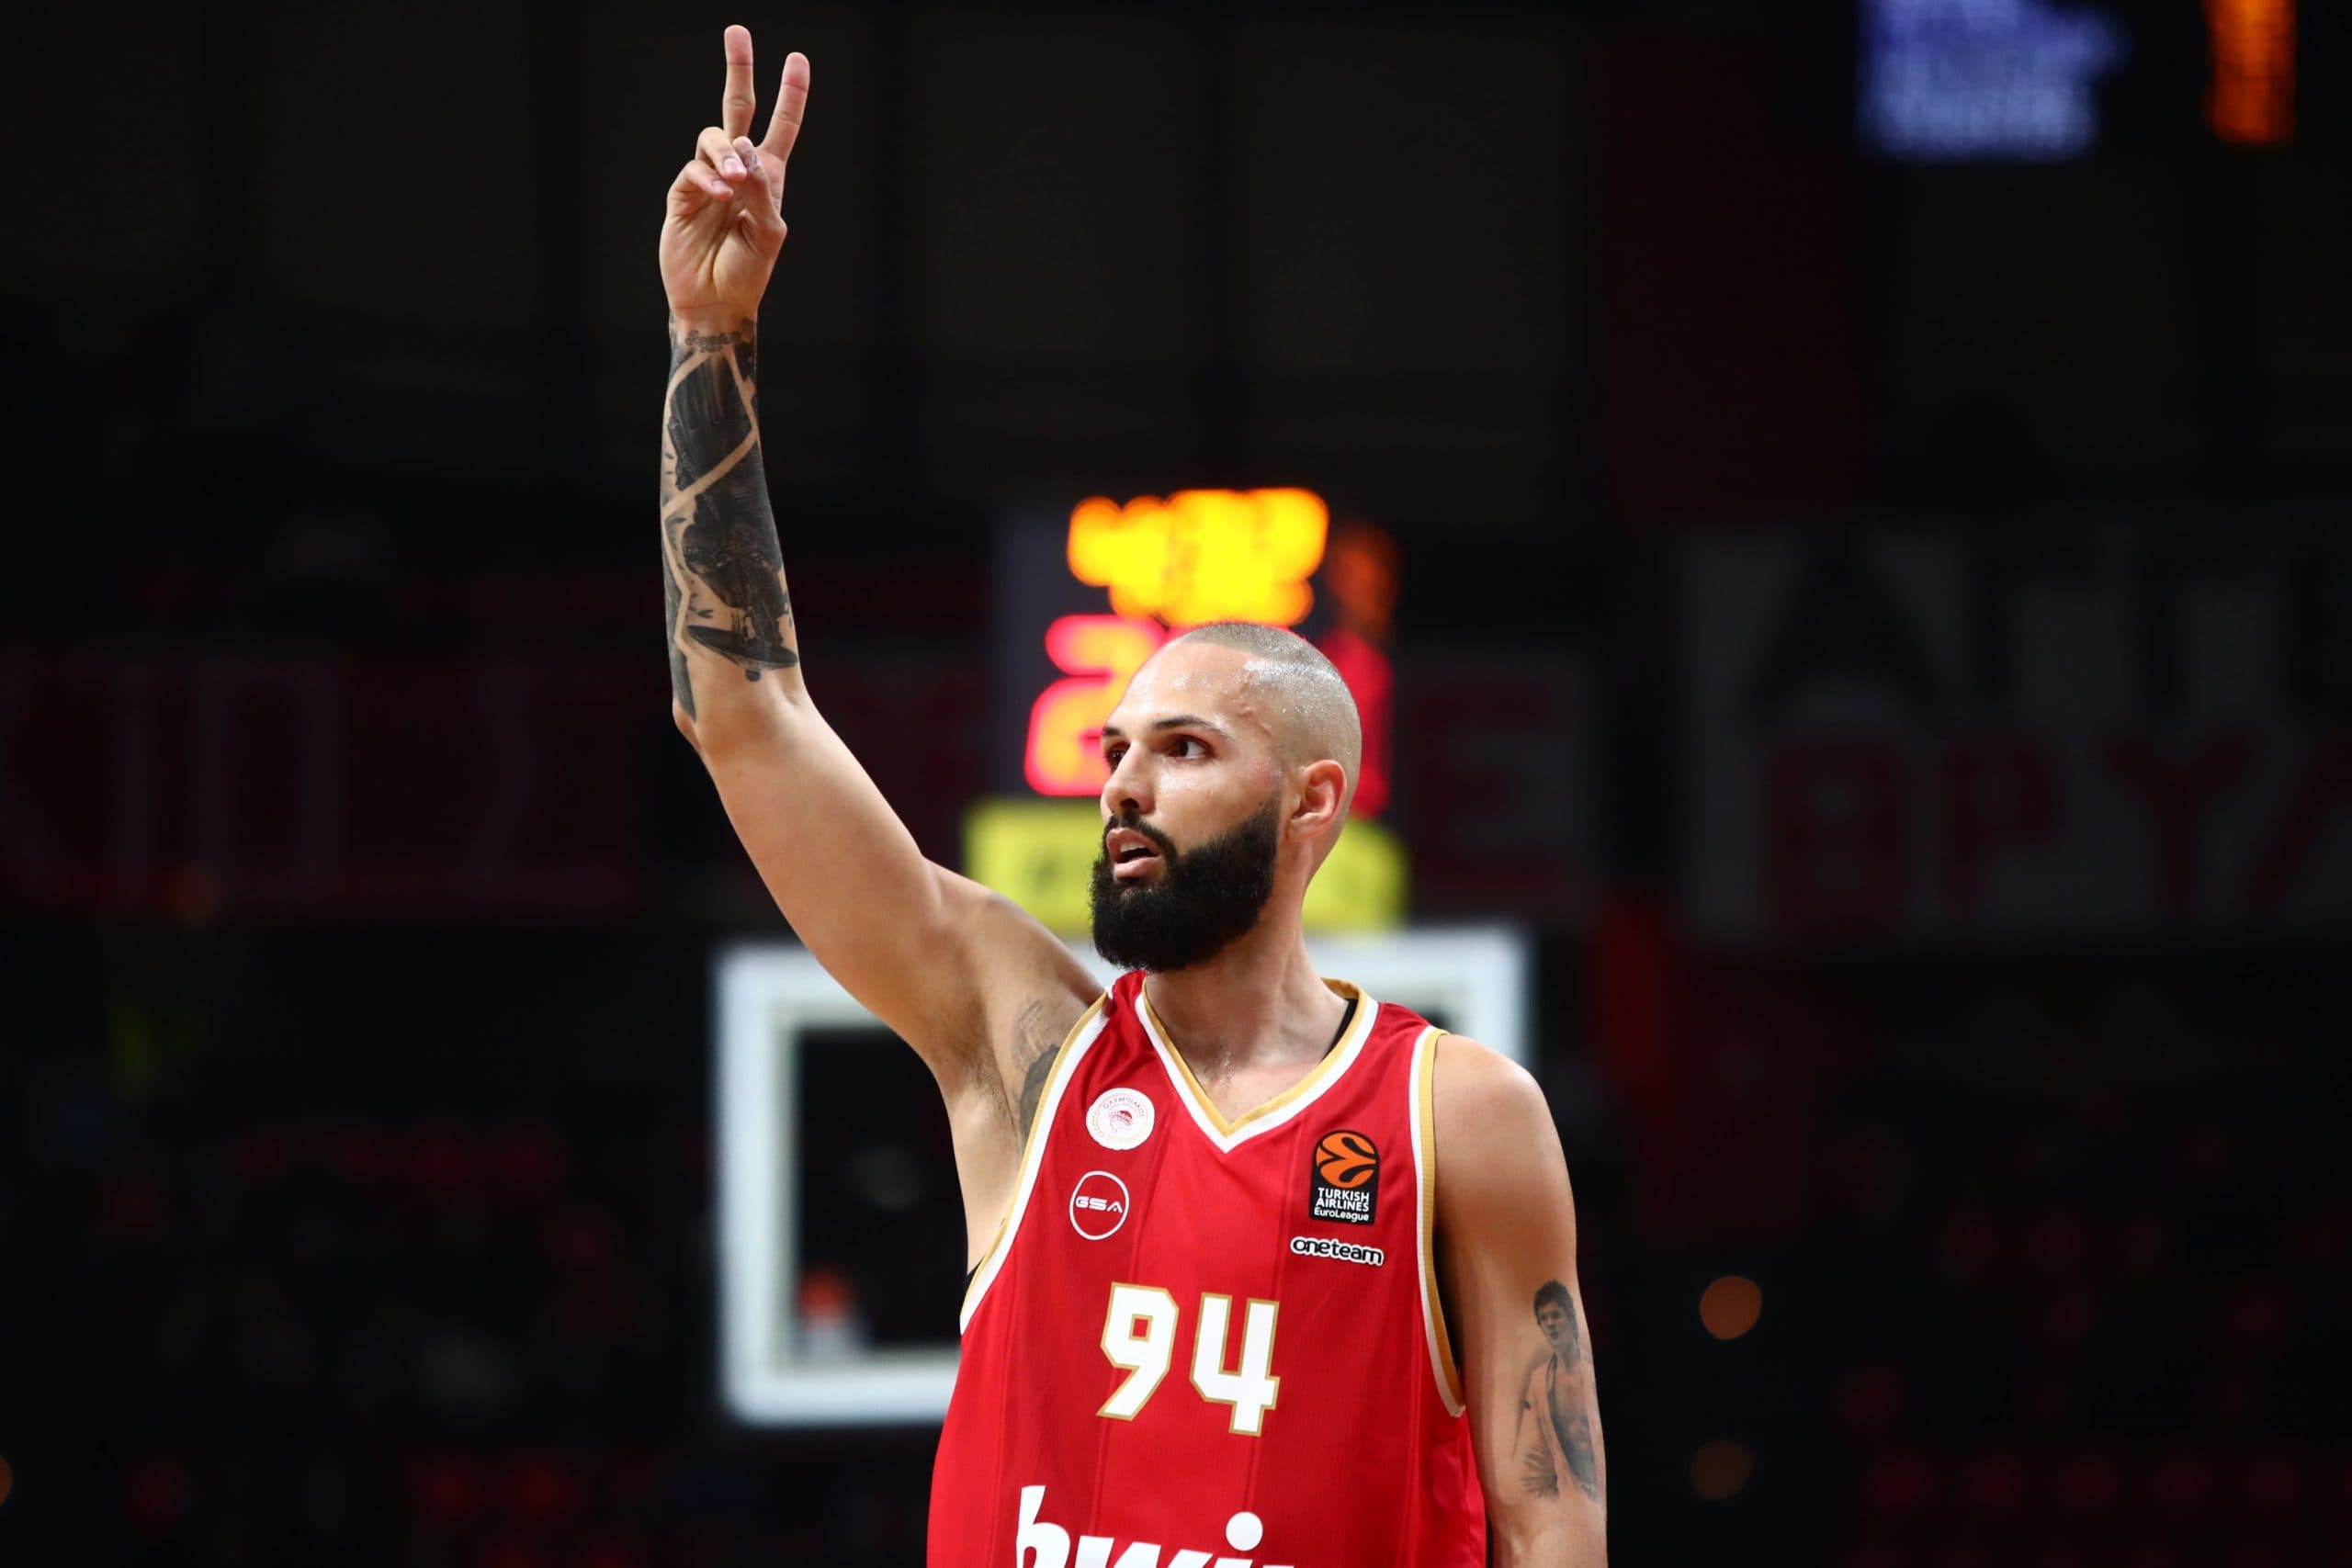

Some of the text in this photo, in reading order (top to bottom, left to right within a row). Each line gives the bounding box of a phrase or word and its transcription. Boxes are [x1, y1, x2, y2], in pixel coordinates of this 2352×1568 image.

[1317, 1188, 1370, 1202] TURKISH
[1076, 1196, 1123, 1213] GSA
[1316, 1197, 1370, 1213] AIRLINES
[1314, 1207, 1370, 1223] EuroLeague
[1292, 1238, 1383, 1265] oneteam
[1096, 1281, 1281, 1438] 94
